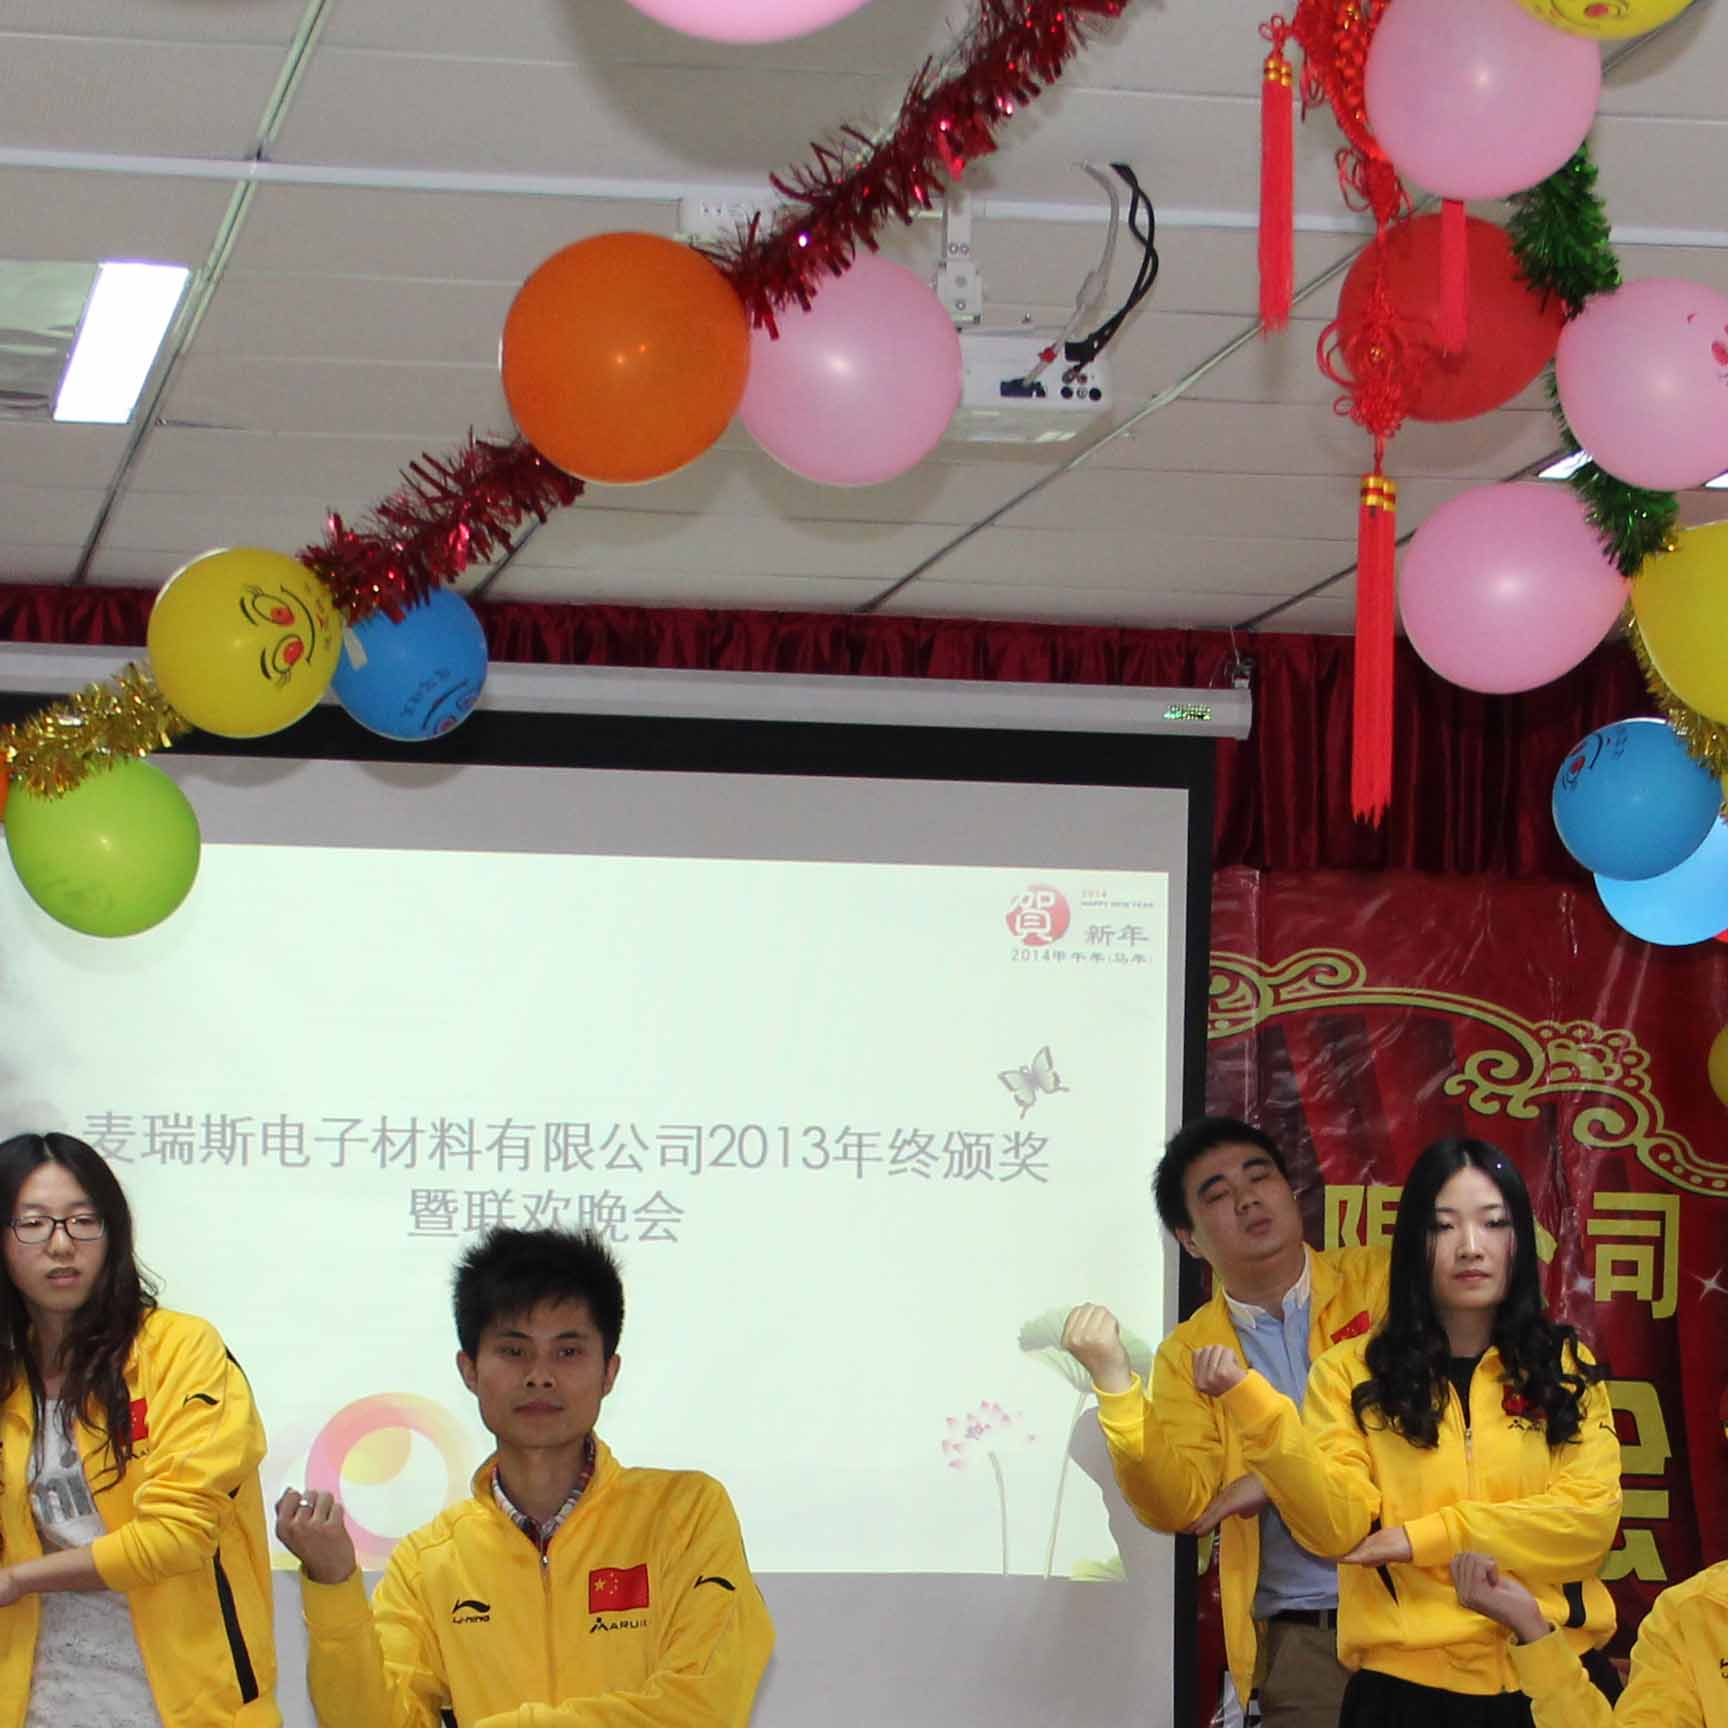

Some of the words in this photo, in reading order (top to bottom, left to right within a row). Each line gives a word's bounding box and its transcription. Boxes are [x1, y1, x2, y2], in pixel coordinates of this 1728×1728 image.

[1084, 923, 1150, 947] 新年
[81, 1111, 1051, 1184] 麦瑞斯电子材料有限公司2013年终颁奖
[407, 1187, 686, 1243] 暨联欢晚会
